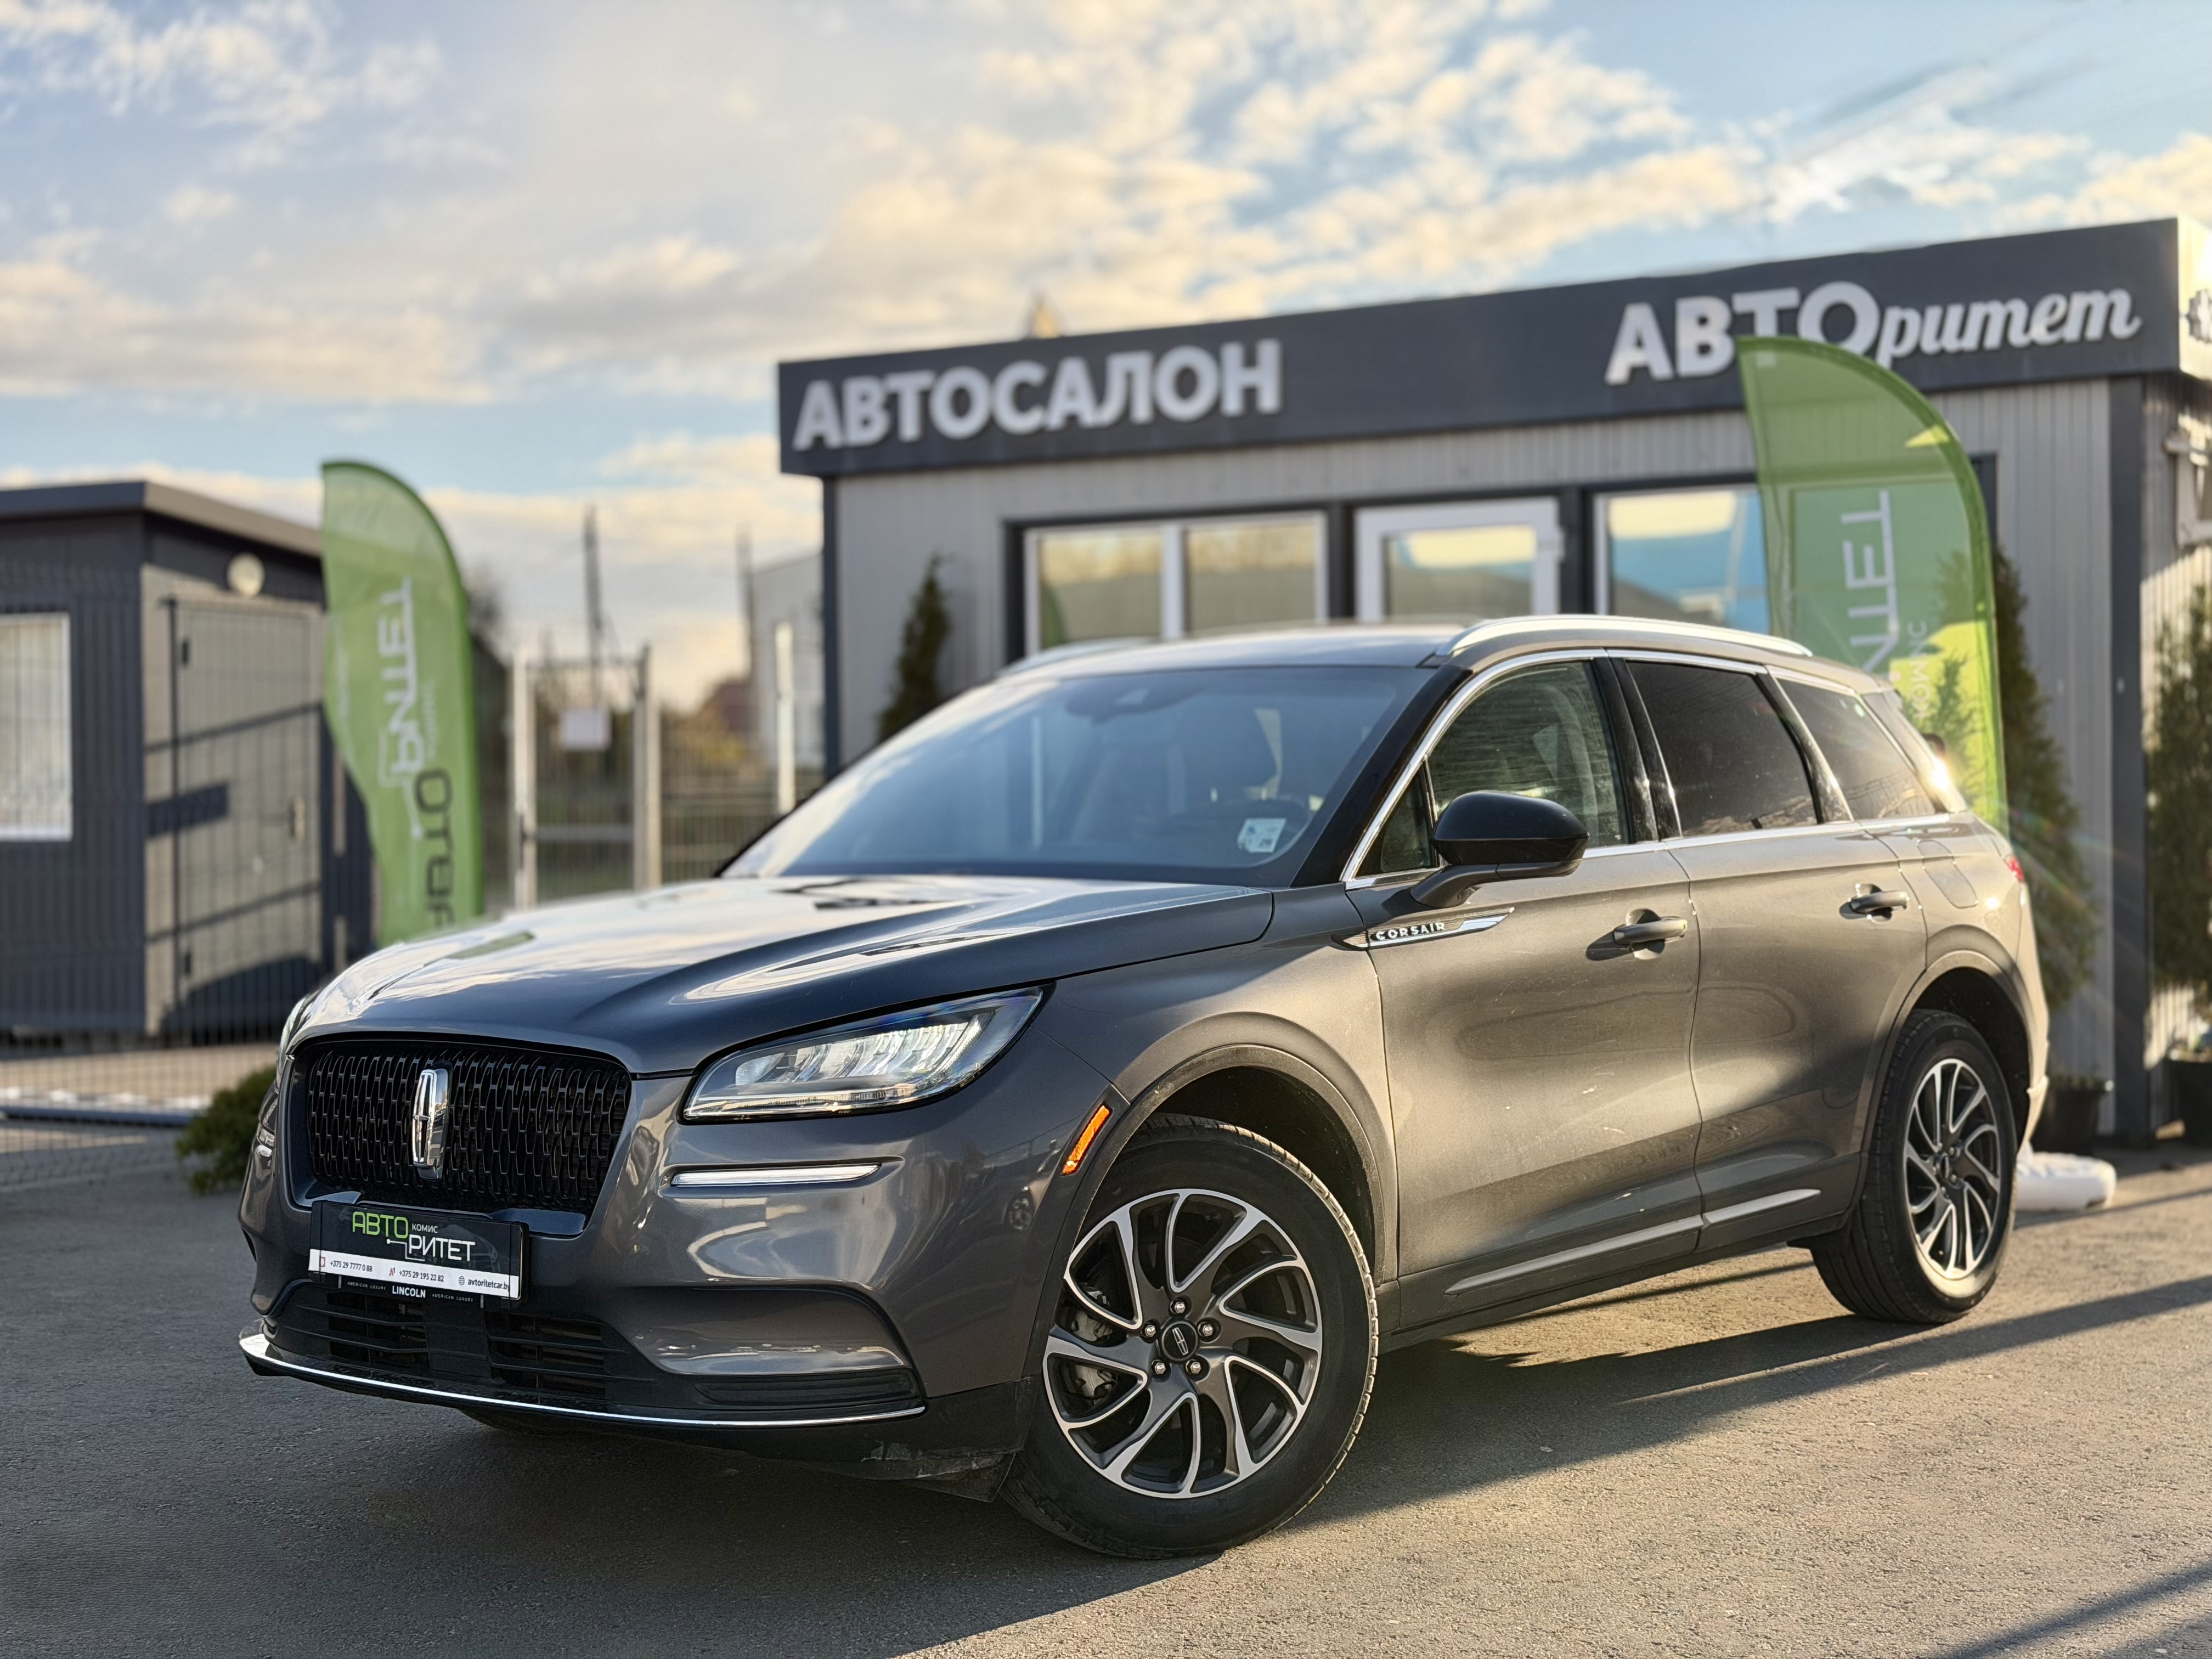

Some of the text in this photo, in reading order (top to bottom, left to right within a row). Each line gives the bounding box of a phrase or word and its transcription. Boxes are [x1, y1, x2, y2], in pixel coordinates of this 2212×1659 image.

[792, 339, 1282, 452] АВТОСАЛОН
[1376, 922, 1445, 940] CORSAIR
[352, 1211, 409, 1239] АВТО
[411, 1223, 438, 1234] КОМИС
[409, 1234, 476, 1262] РИТЕТ
[349, 1262, 362, 1271] 7777
[392, 1285, 426, 1299] LINCOLN
[468, 1278, 510, 1291] avtoritetcar.by
